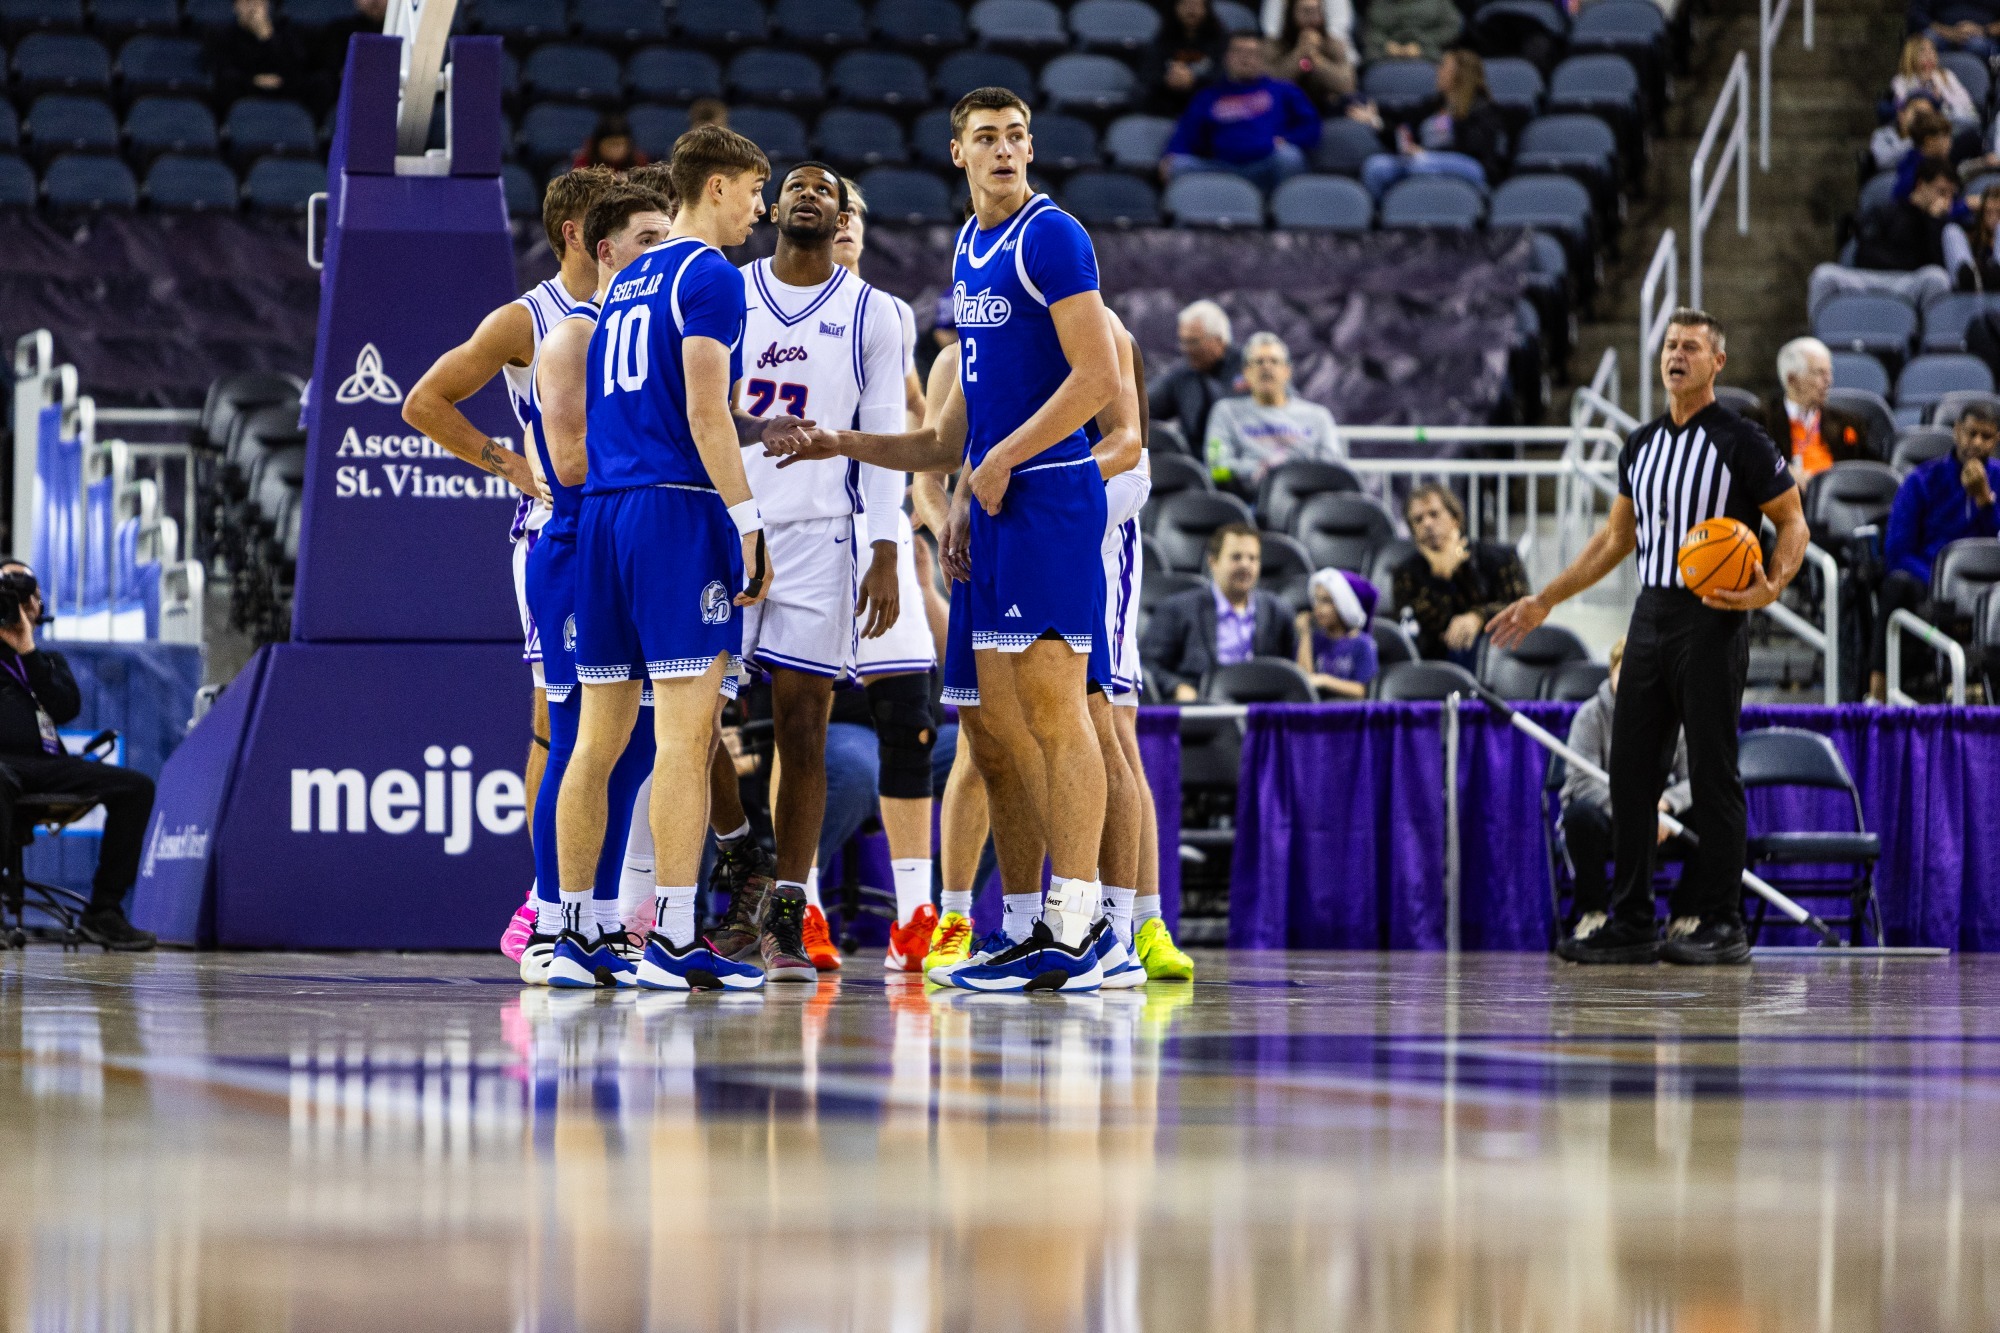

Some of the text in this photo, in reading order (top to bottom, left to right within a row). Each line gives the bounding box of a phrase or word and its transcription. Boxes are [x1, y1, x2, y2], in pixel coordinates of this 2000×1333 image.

[609, 272, 664, 304] SHETLAR
[953, 281, 1010, 327] Drake
[603, 304, 651, 397] 10
[757, 341, 808, 369] Aces
[965, 337, 978, 383] 2
[335, 426, 514, 458] Ascenn
[336, 465, 381, 497] St.
[290, 744, 527, 855] meije
